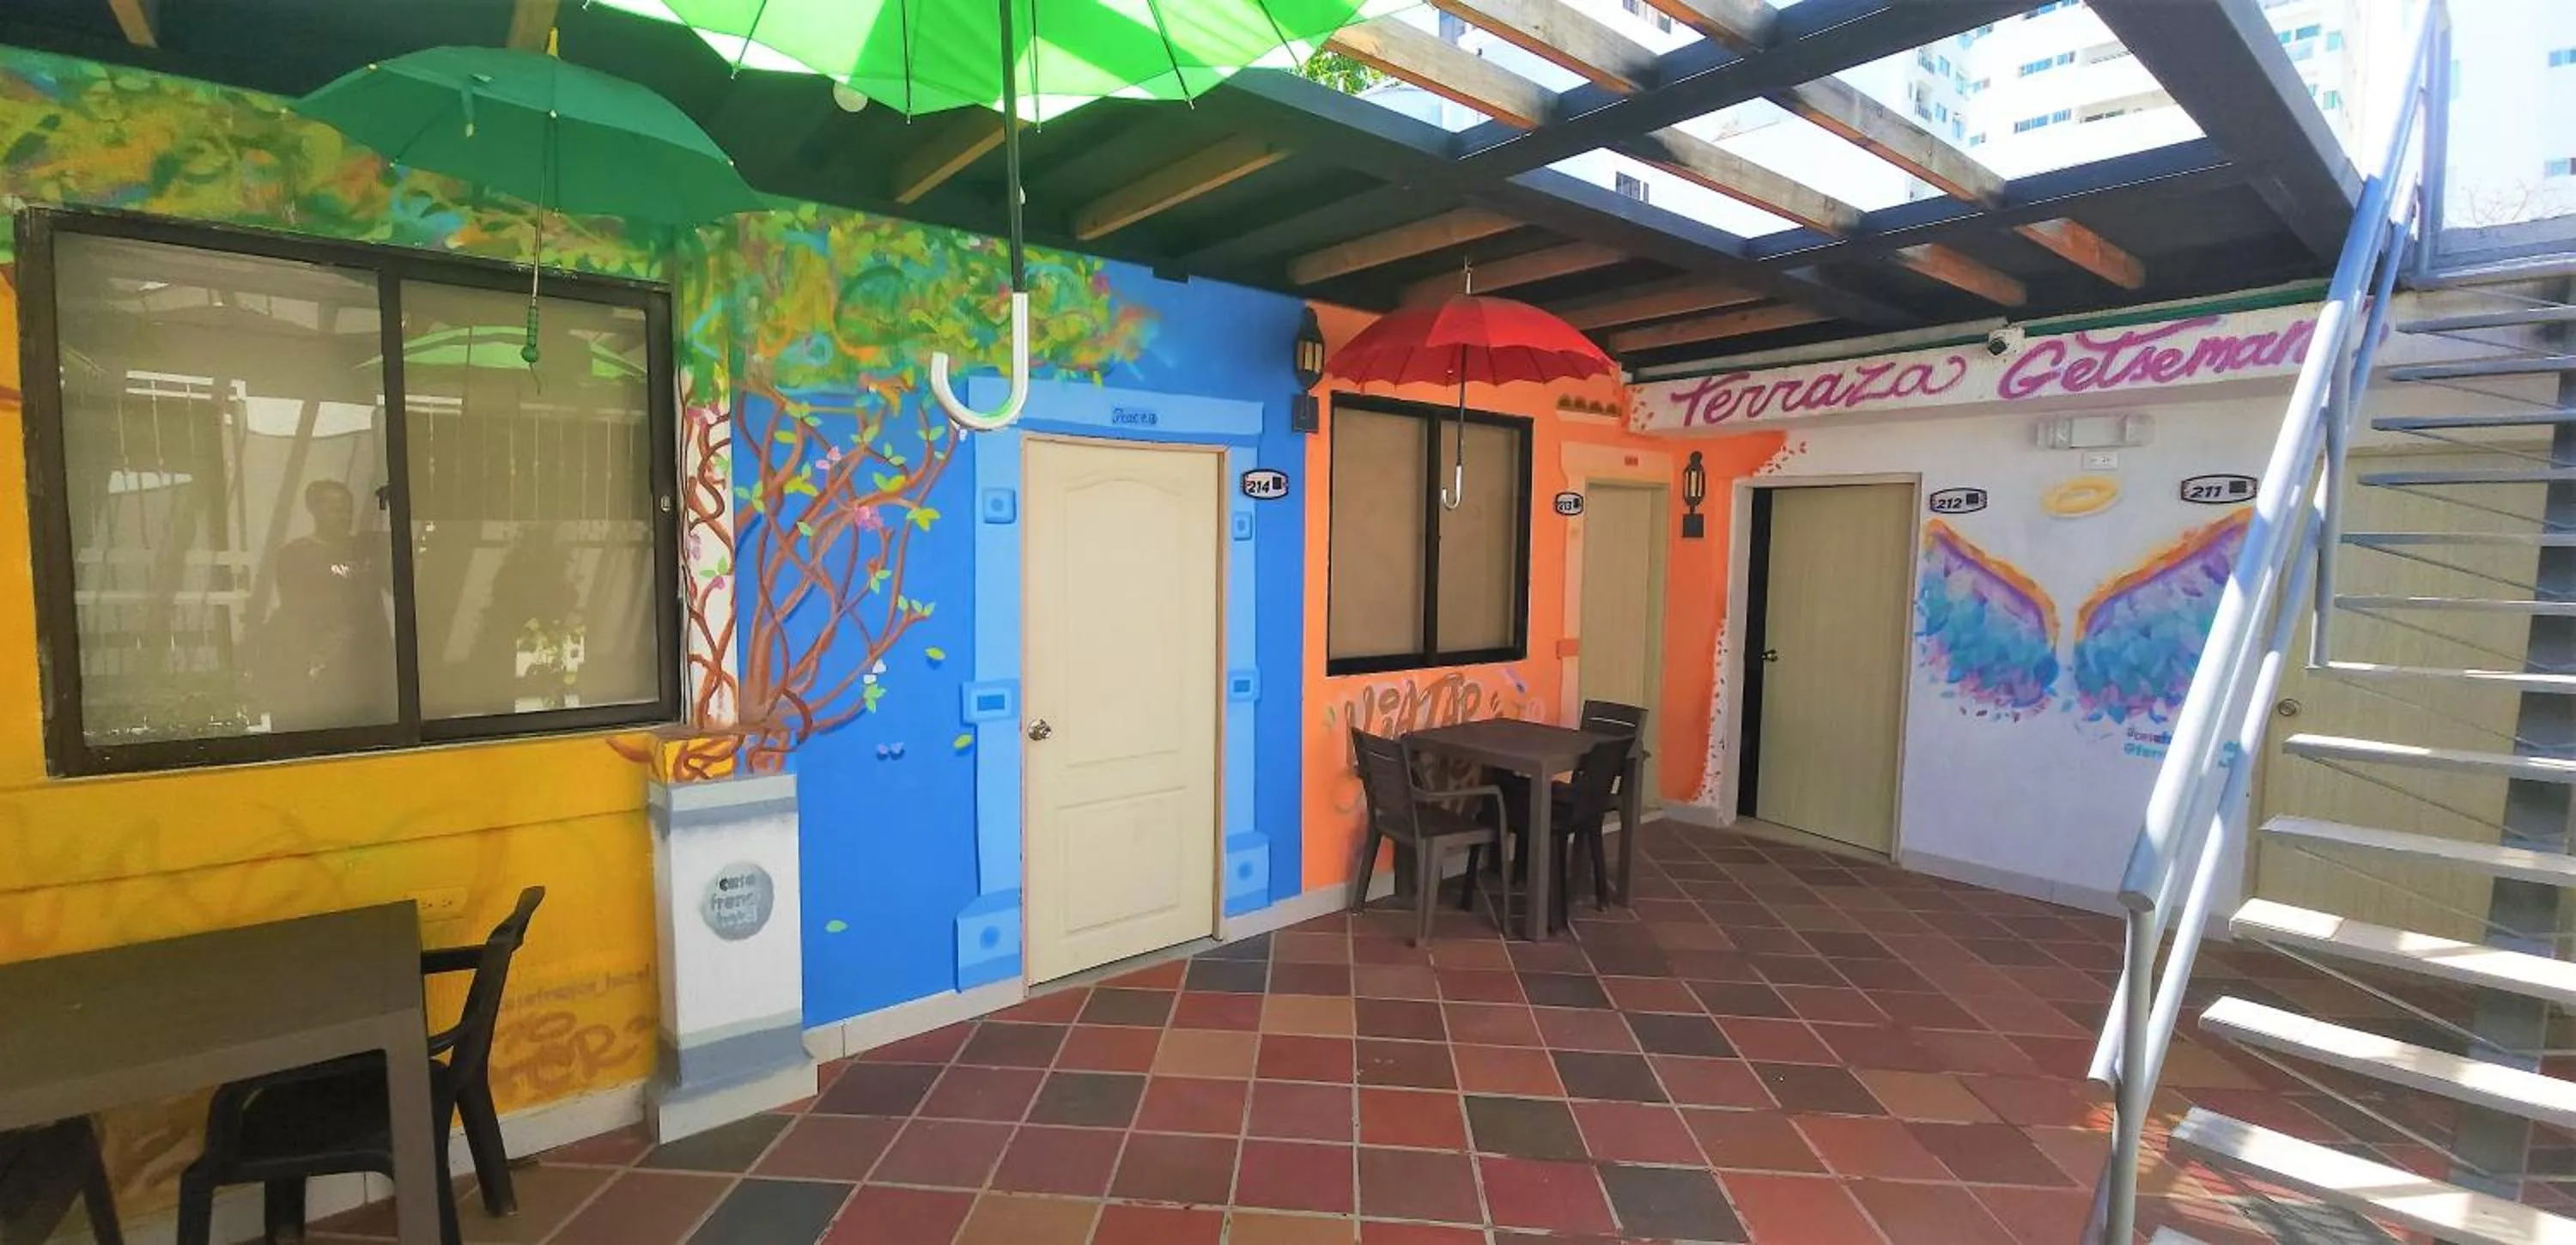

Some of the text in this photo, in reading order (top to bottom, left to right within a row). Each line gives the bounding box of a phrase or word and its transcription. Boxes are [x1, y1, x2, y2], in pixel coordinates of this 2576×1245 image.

[1249, 480, 1270, 494] 214
[2190, 485, 2222, 498] 211
[1558, 501, 1572, 511] 213
[1936, 497, 1962, 509] 212
